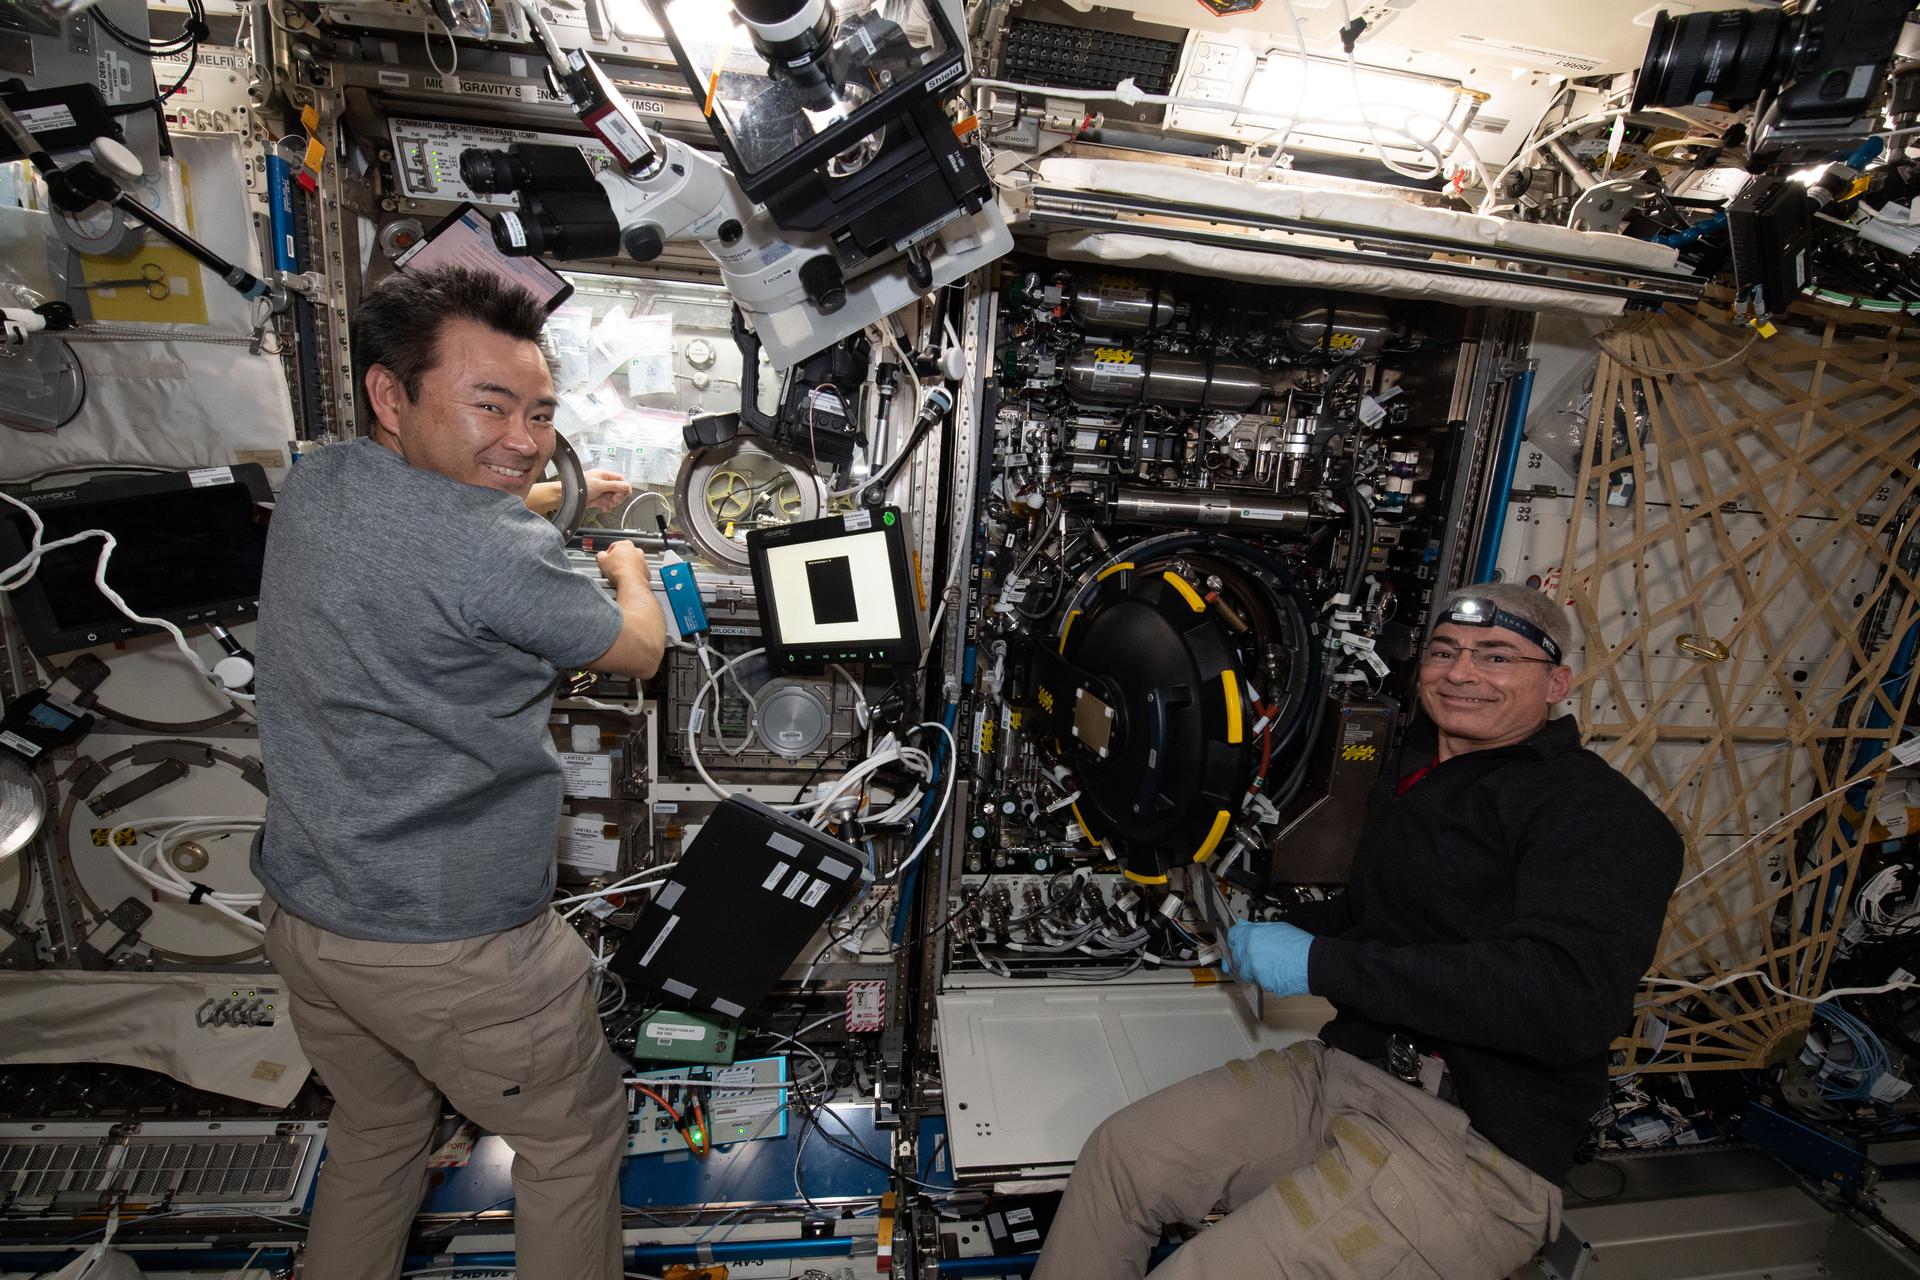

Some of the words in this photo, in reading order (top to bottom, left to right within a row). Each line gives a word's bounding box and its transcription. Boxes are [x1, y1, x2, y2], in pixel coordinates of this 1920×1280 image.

[196, 55, 235, 68] MELFI)
[235, 57, 245, 68] 3
[928, 64, 960, 89] Shield
[631, 102, 664, 114] (MSG)
[396, 119, 432, 130] COMMAND
[433, 122, 449, 131] AND
[449, 124, 493, 136] MONITORING
[493, 128, 517, 139] PANEL
[518, 131, 539, 140] (CMP)
[763, 273, 784, 286] Focus
[1204, 513, 1225, 521] FLOW
[709, 628, 737, 636] AIRLOCK
[447, 1141, 469, 1151] PORT
